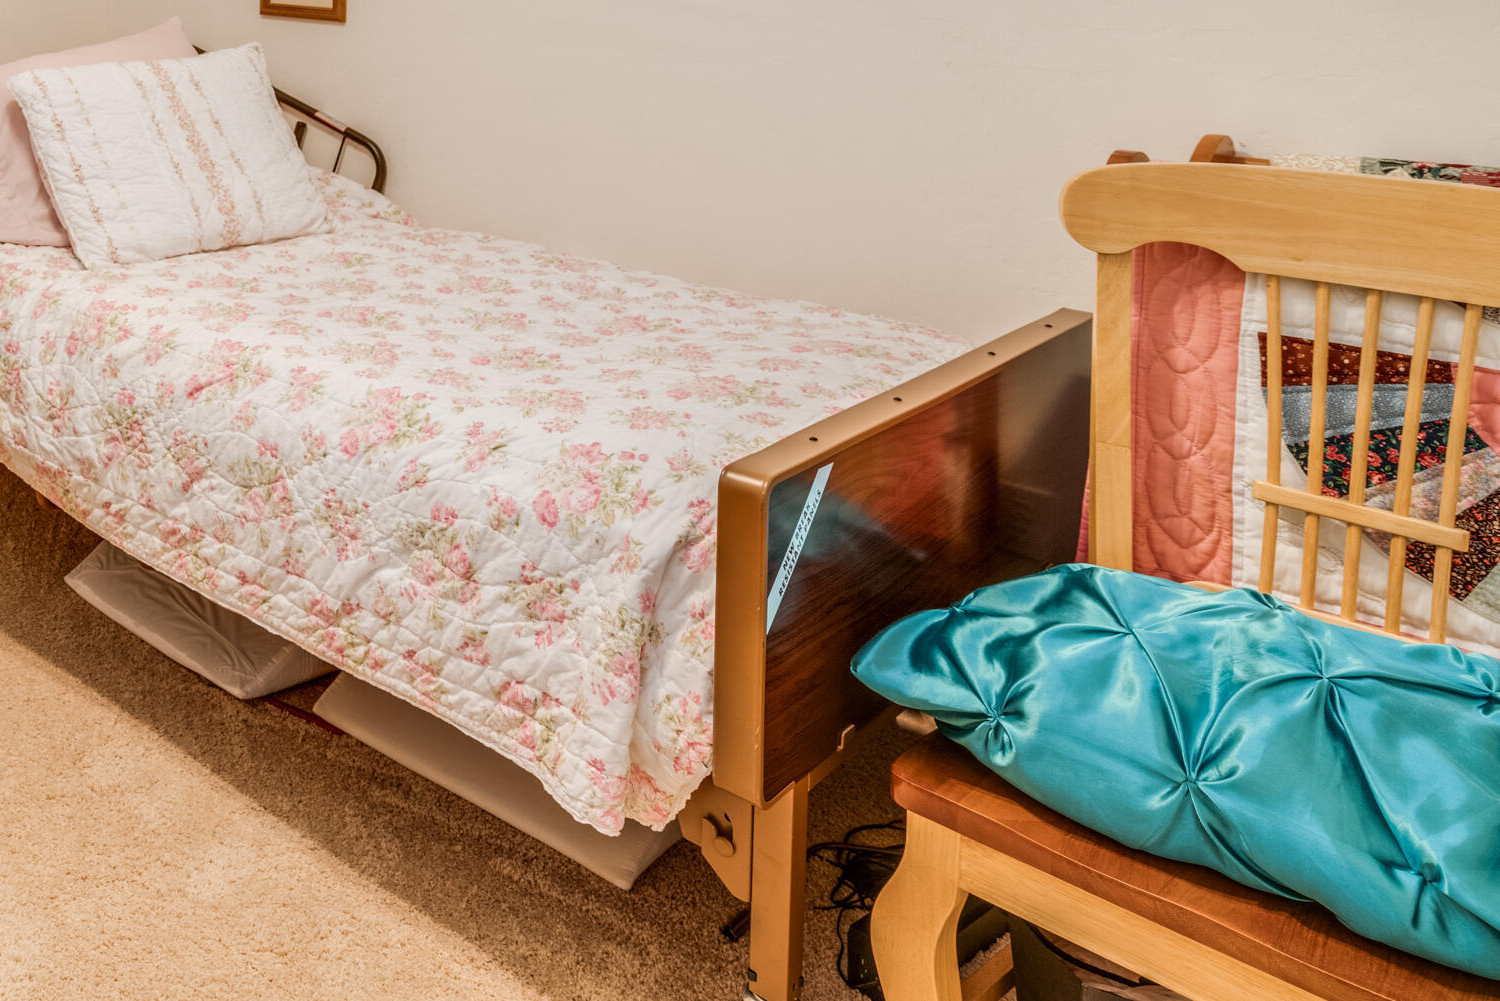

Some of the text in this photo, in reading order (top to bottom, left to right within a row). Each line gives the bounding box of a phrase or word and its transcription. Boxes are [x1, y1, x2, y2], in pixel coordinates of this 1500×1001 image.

[779, 489, 821, 597] RESISTANT PANELS
[783, 502, 810, 570] NEW BREAK
